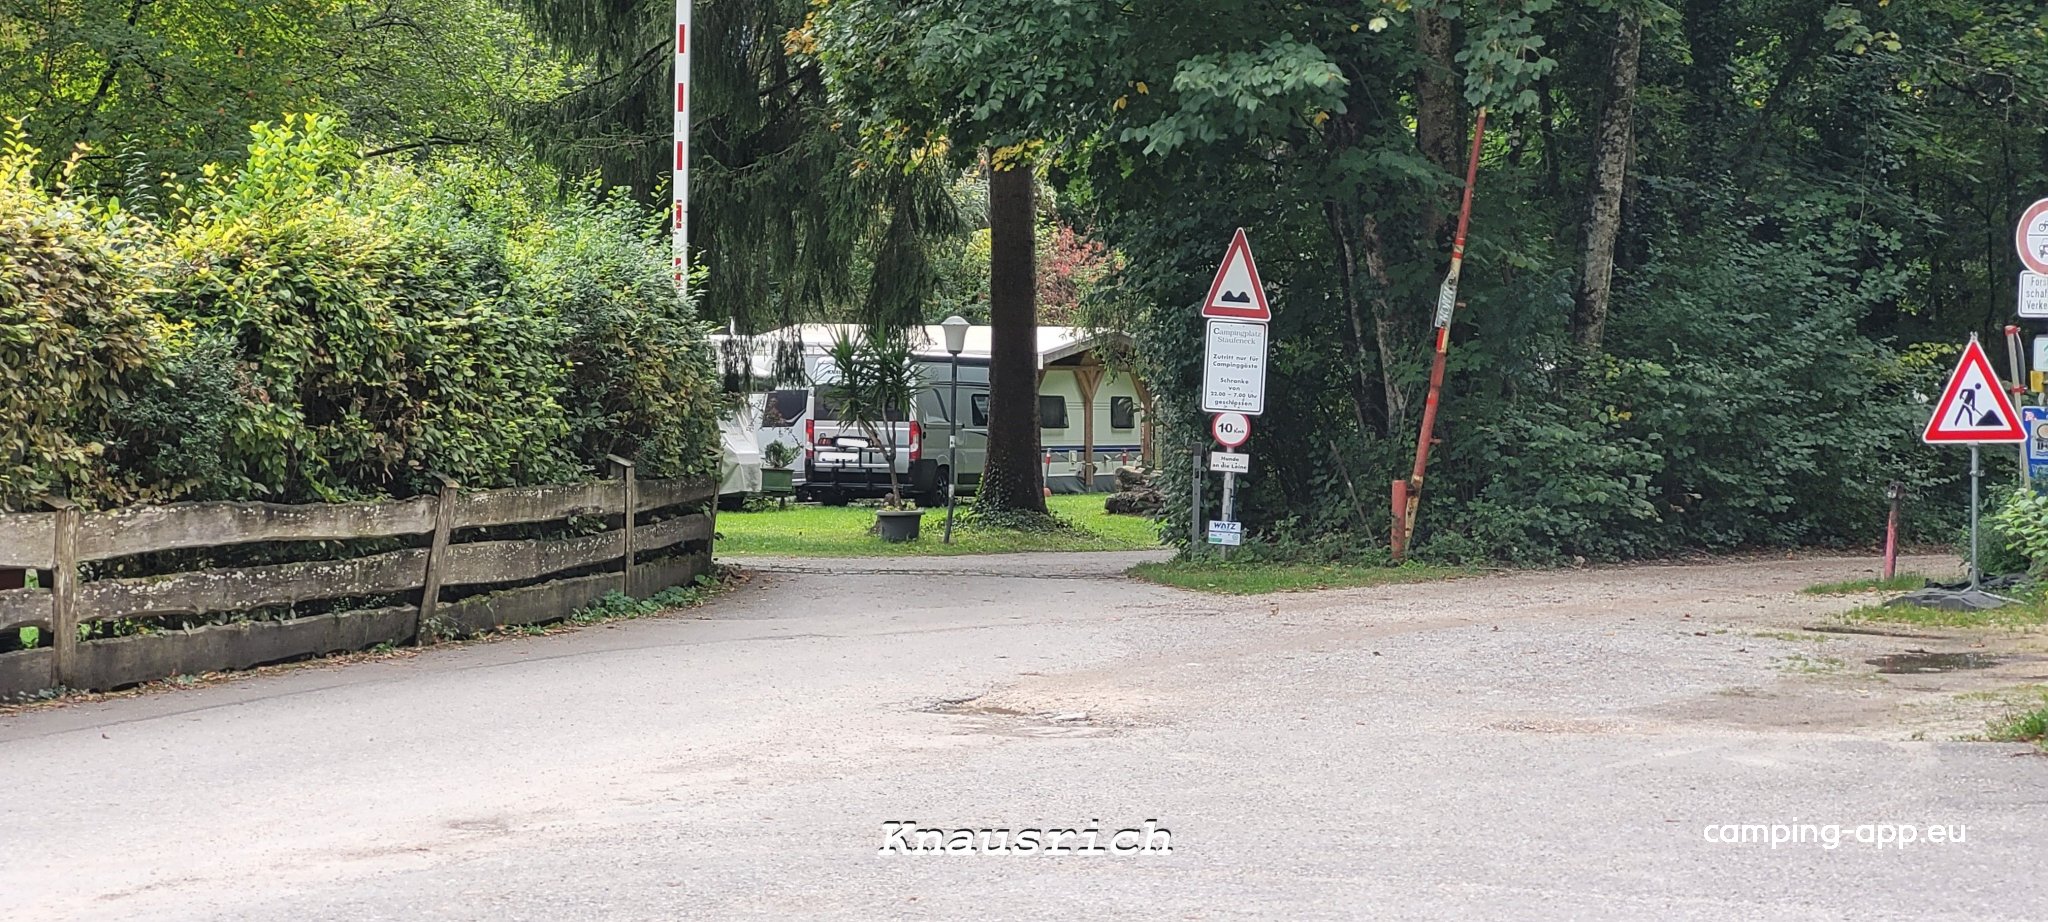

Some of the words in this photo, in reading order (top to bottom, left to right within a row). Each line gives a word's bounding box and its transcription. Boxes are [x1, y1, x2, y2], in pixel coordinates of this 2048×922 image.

[1213, 327, 1262, 337] Campingplatz
[1213, 361, 1258, 369] Campinggäste
[1218, 423, 1233, 433] 10
[1214, 522, 1237, 530] WATZ
